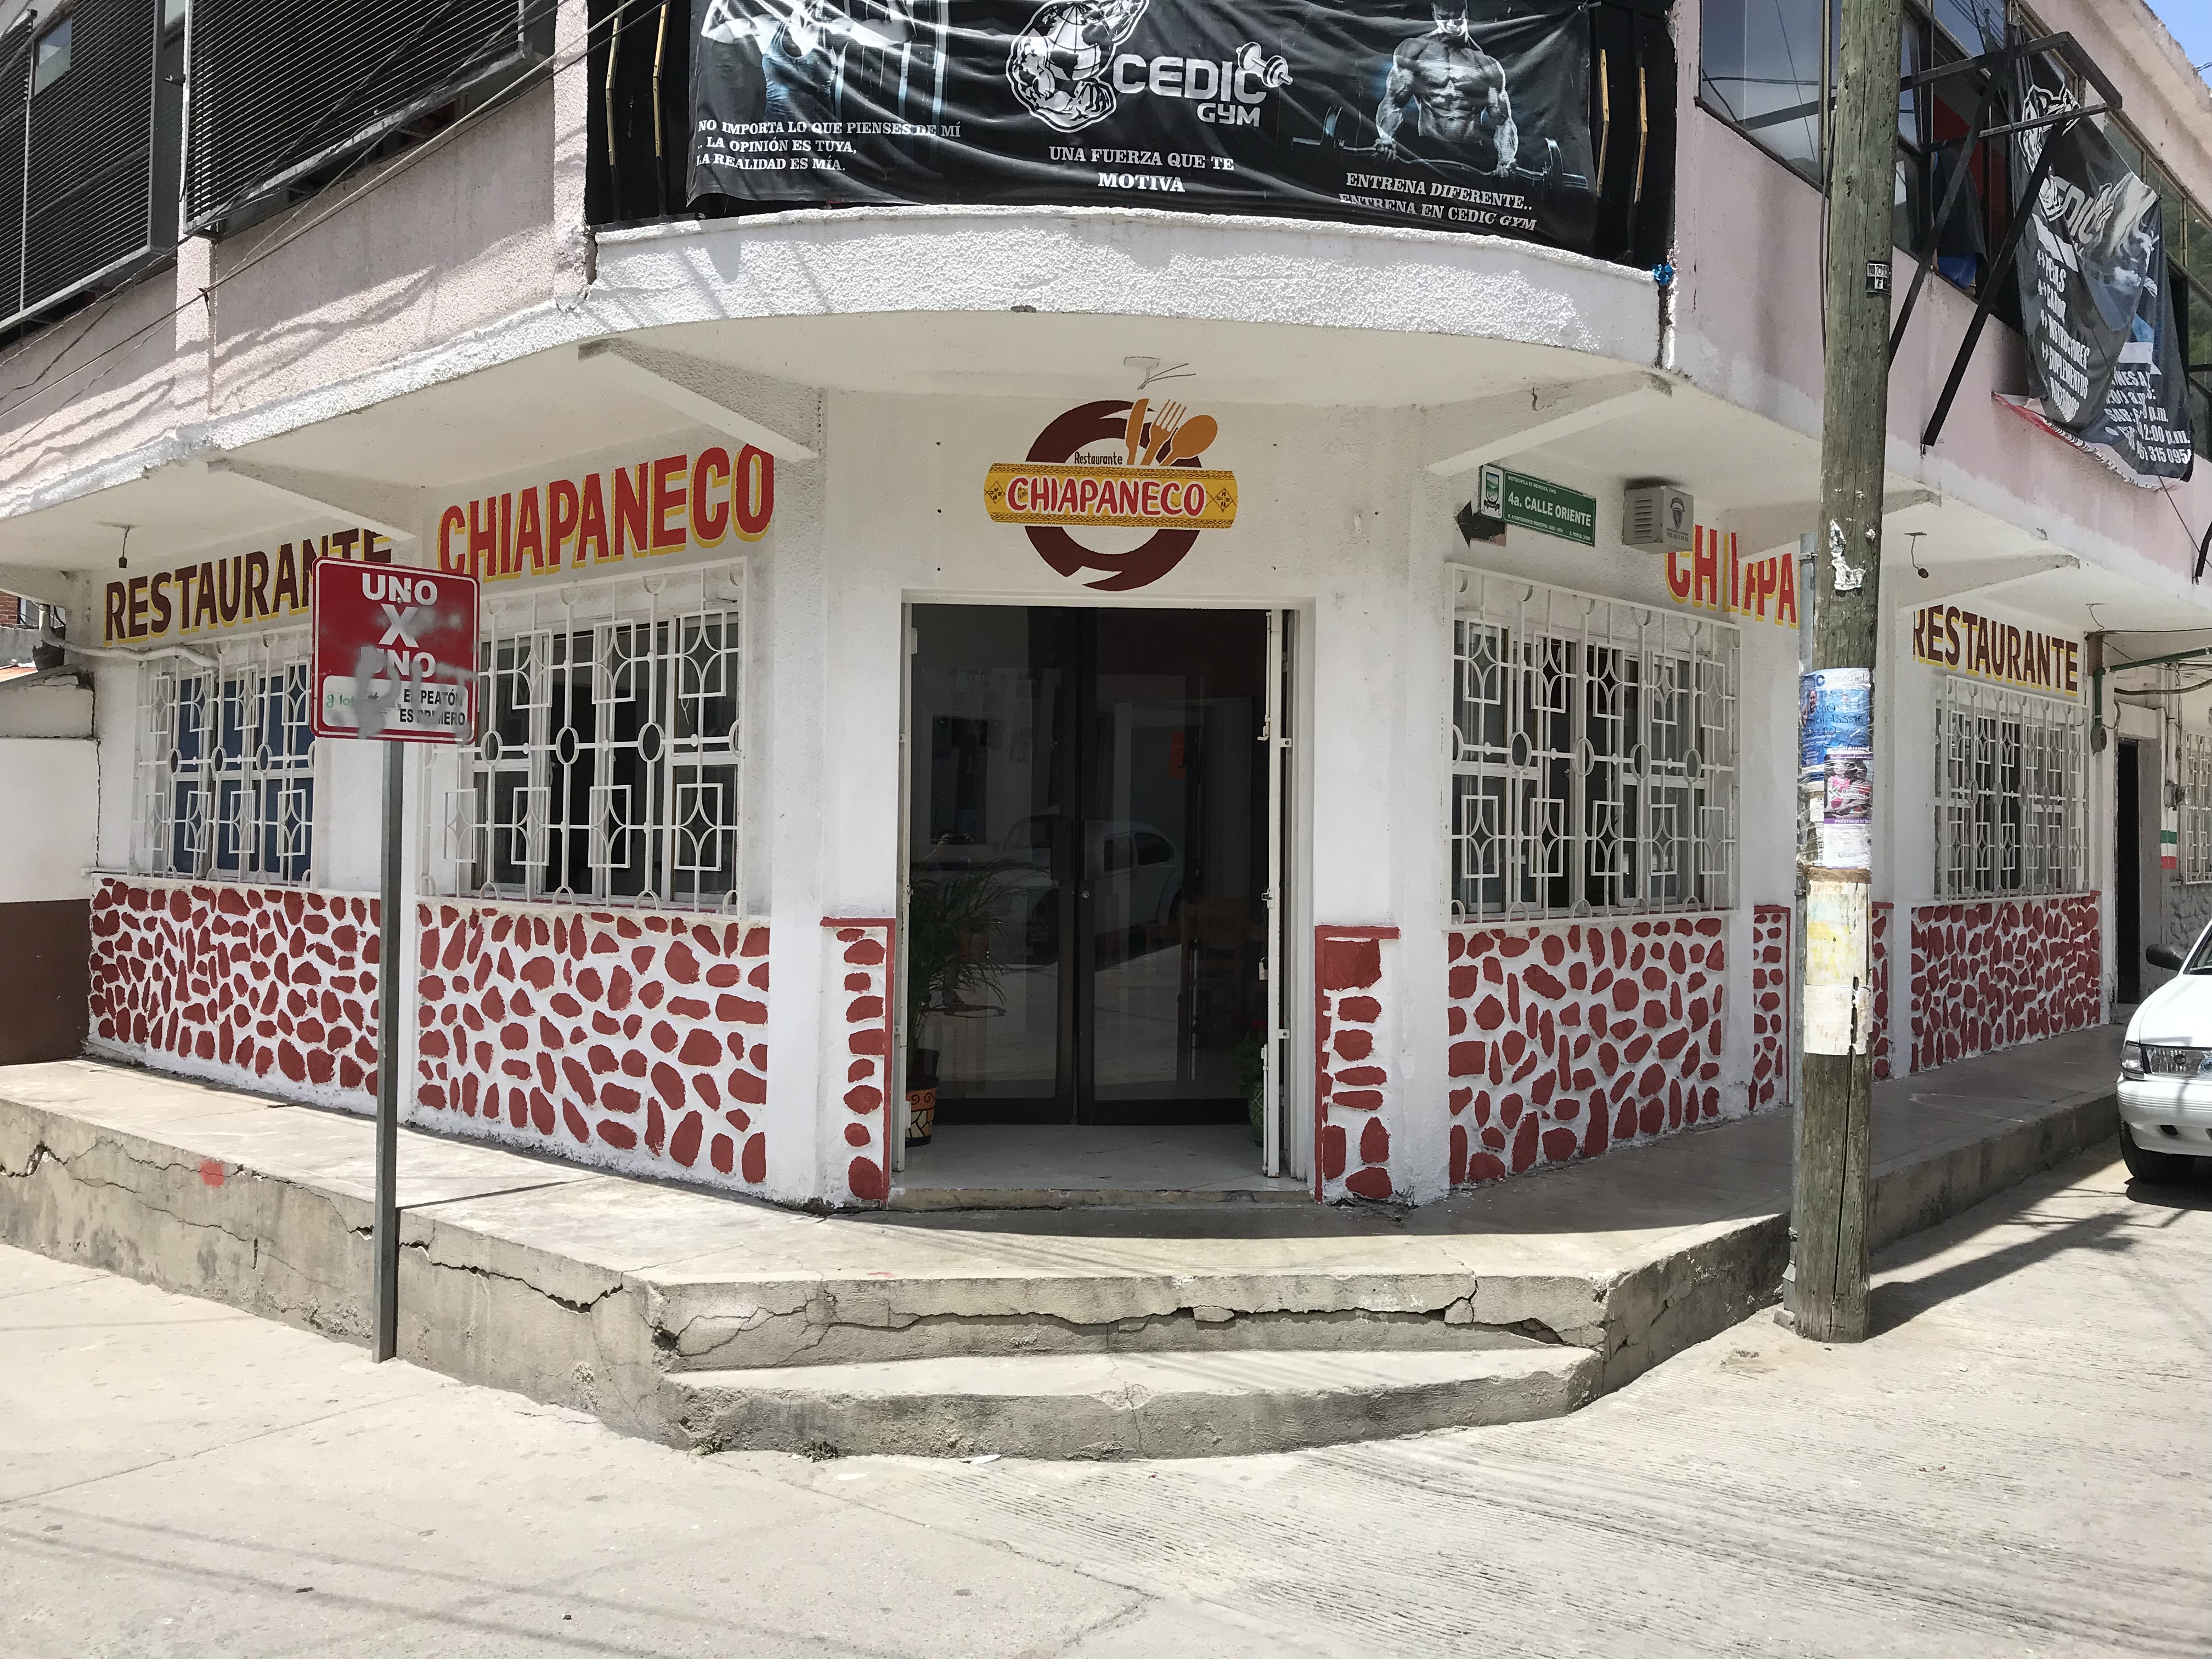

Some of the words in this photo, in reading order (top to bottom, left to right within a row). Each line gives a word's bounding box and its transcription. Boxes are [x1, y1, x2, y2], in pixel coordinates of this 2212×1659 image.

[1113, 53, 1267, 104] CEDIC
[698, 120, 718, 132] NO
[721, 121, 785, 135] IMPORTA
[787, 121, 808, 133] LO
[811, 122, 843, 134] QUE
[847, 122, 911, 135] PIENSES
[915, 124, 936, 136] DE
[941, 121, 961, 137] MÍ
[1197, 103, 1260, 127] GYM
[706, 136, 725, 148] LA
[729, 137, 788, 153] OPINIÓN
[792, 139, 811, 151] ES
[815, 140, 857, 155] TUYA,
[1049, 146, 1085, 161] UNA
[1091, 148, 1163, 166] FUERZA
[1167, 153, 1205, 168] QUE
[1210, 157, 1234, 170] TE
[696, 154, 710, 166] LA
[714, 153, 786, 170] REALIDAD
[790, 157, 808, 170] ES
[812, 155, 845, 171] MÍA.
[1098, 172, 1185, 192] MOTIVA
[1346, 172, 1426, 195] ENTRENA
[1430, 183, 1533, 211] DIFERENTE..
[1421, 204, 1444, 219] EN
[1448, 206, 1497, 224] CEDIC
[1499, 215, 1537, 231] GYM
[1074, 452, 1123, 465] Restaurante
[1007, 476, 1206, 516] CHIAPANECO
[1508, 492, 1522, 507] 4a.
[1525, 496, 1553, 516] CALLE
[1555, 505, 1592, 527] ORIENTE
[439, 443, 774, 583] CHIAPANECO
[362, 573, 438, 606] UNO
[380, 603, 419, 648] X
[1912, 604, 2078, 696] RESTAURANTE
[399, 708, 414, 723] ES
